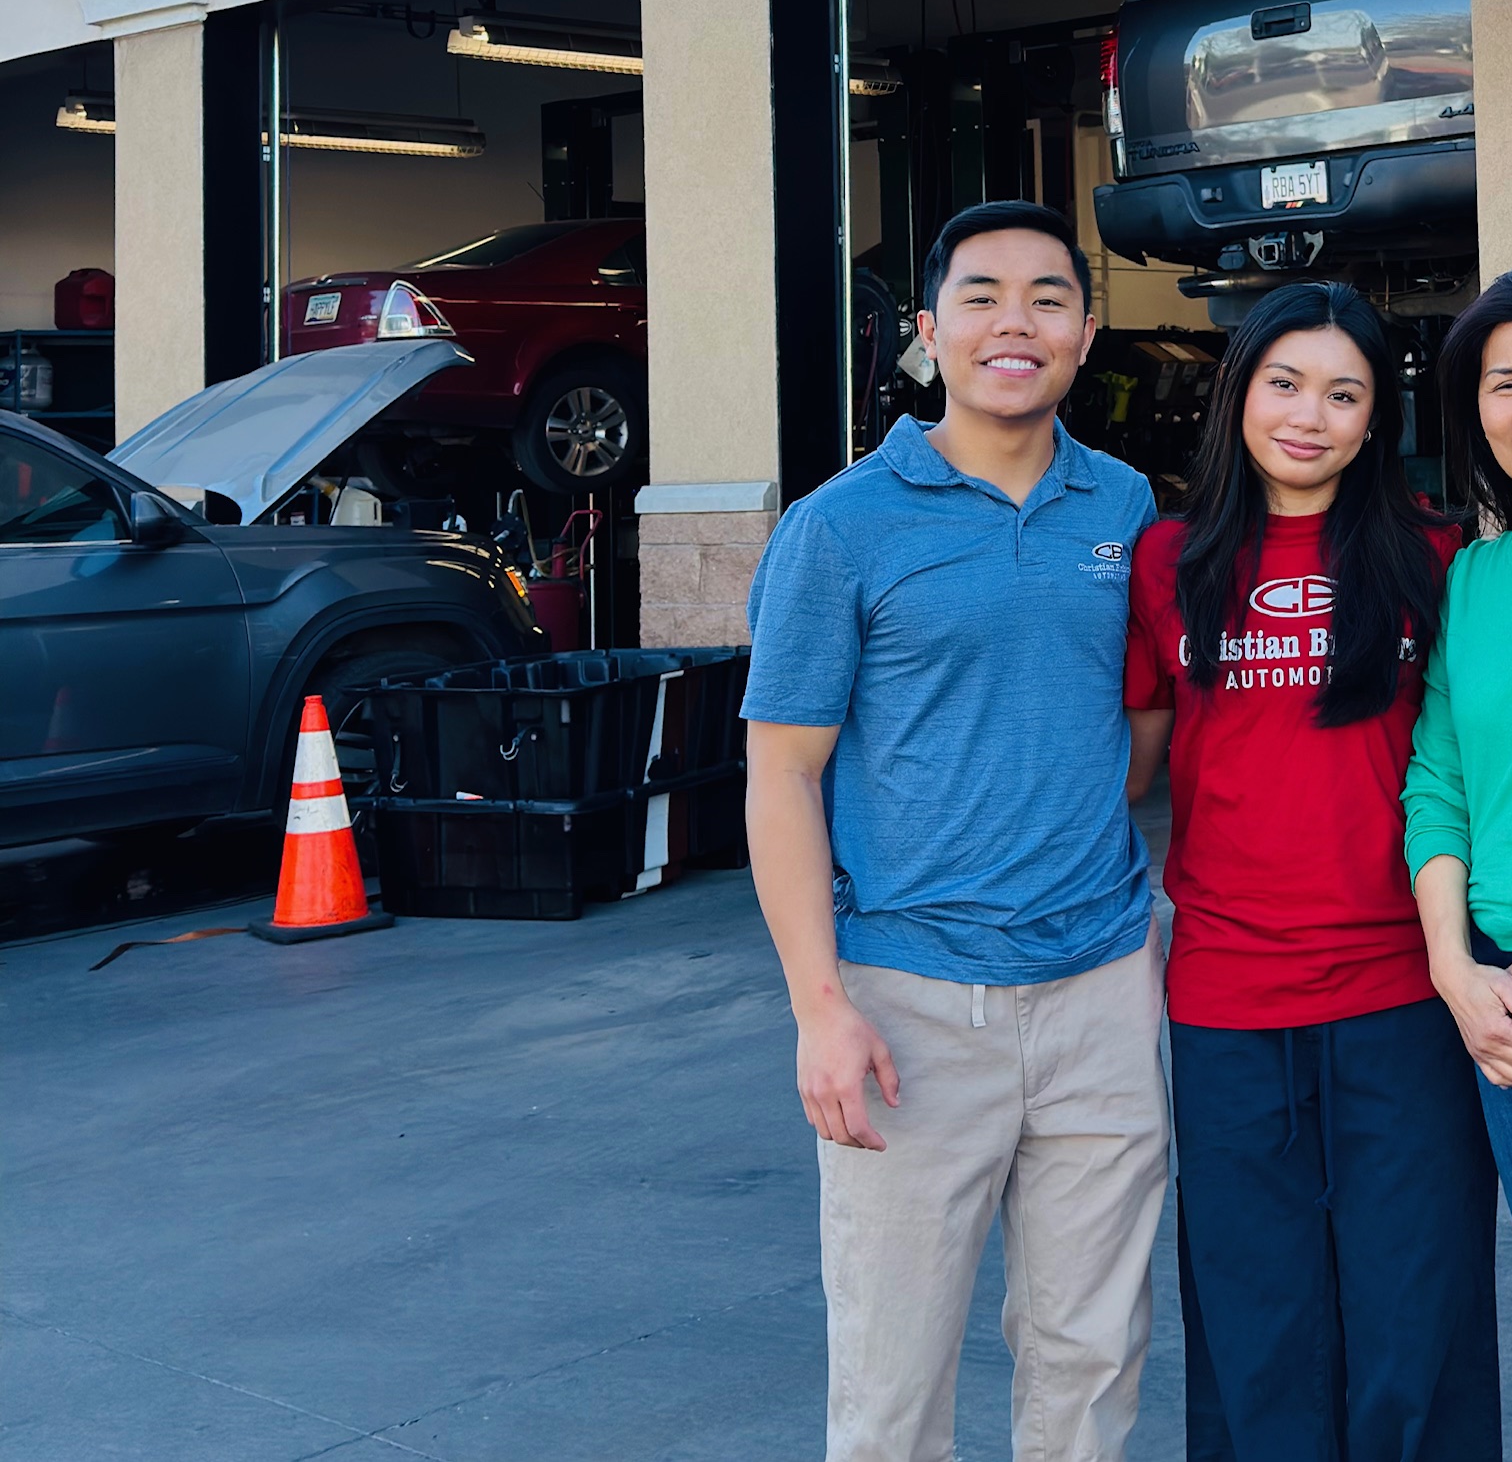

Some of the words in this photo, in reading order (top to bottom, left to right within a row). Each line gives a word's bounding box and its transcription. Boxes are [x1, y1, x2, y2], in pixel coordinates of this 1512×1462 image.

[1272, 176, 1295, 199] RBA
[1299, 172, 1320, 196] 5YT
[1077, 563, 1115, 572] Christian
[1178, 629, 1301, 667] Cistian
[1225, 665, 1334, 690] AUTOMOT
